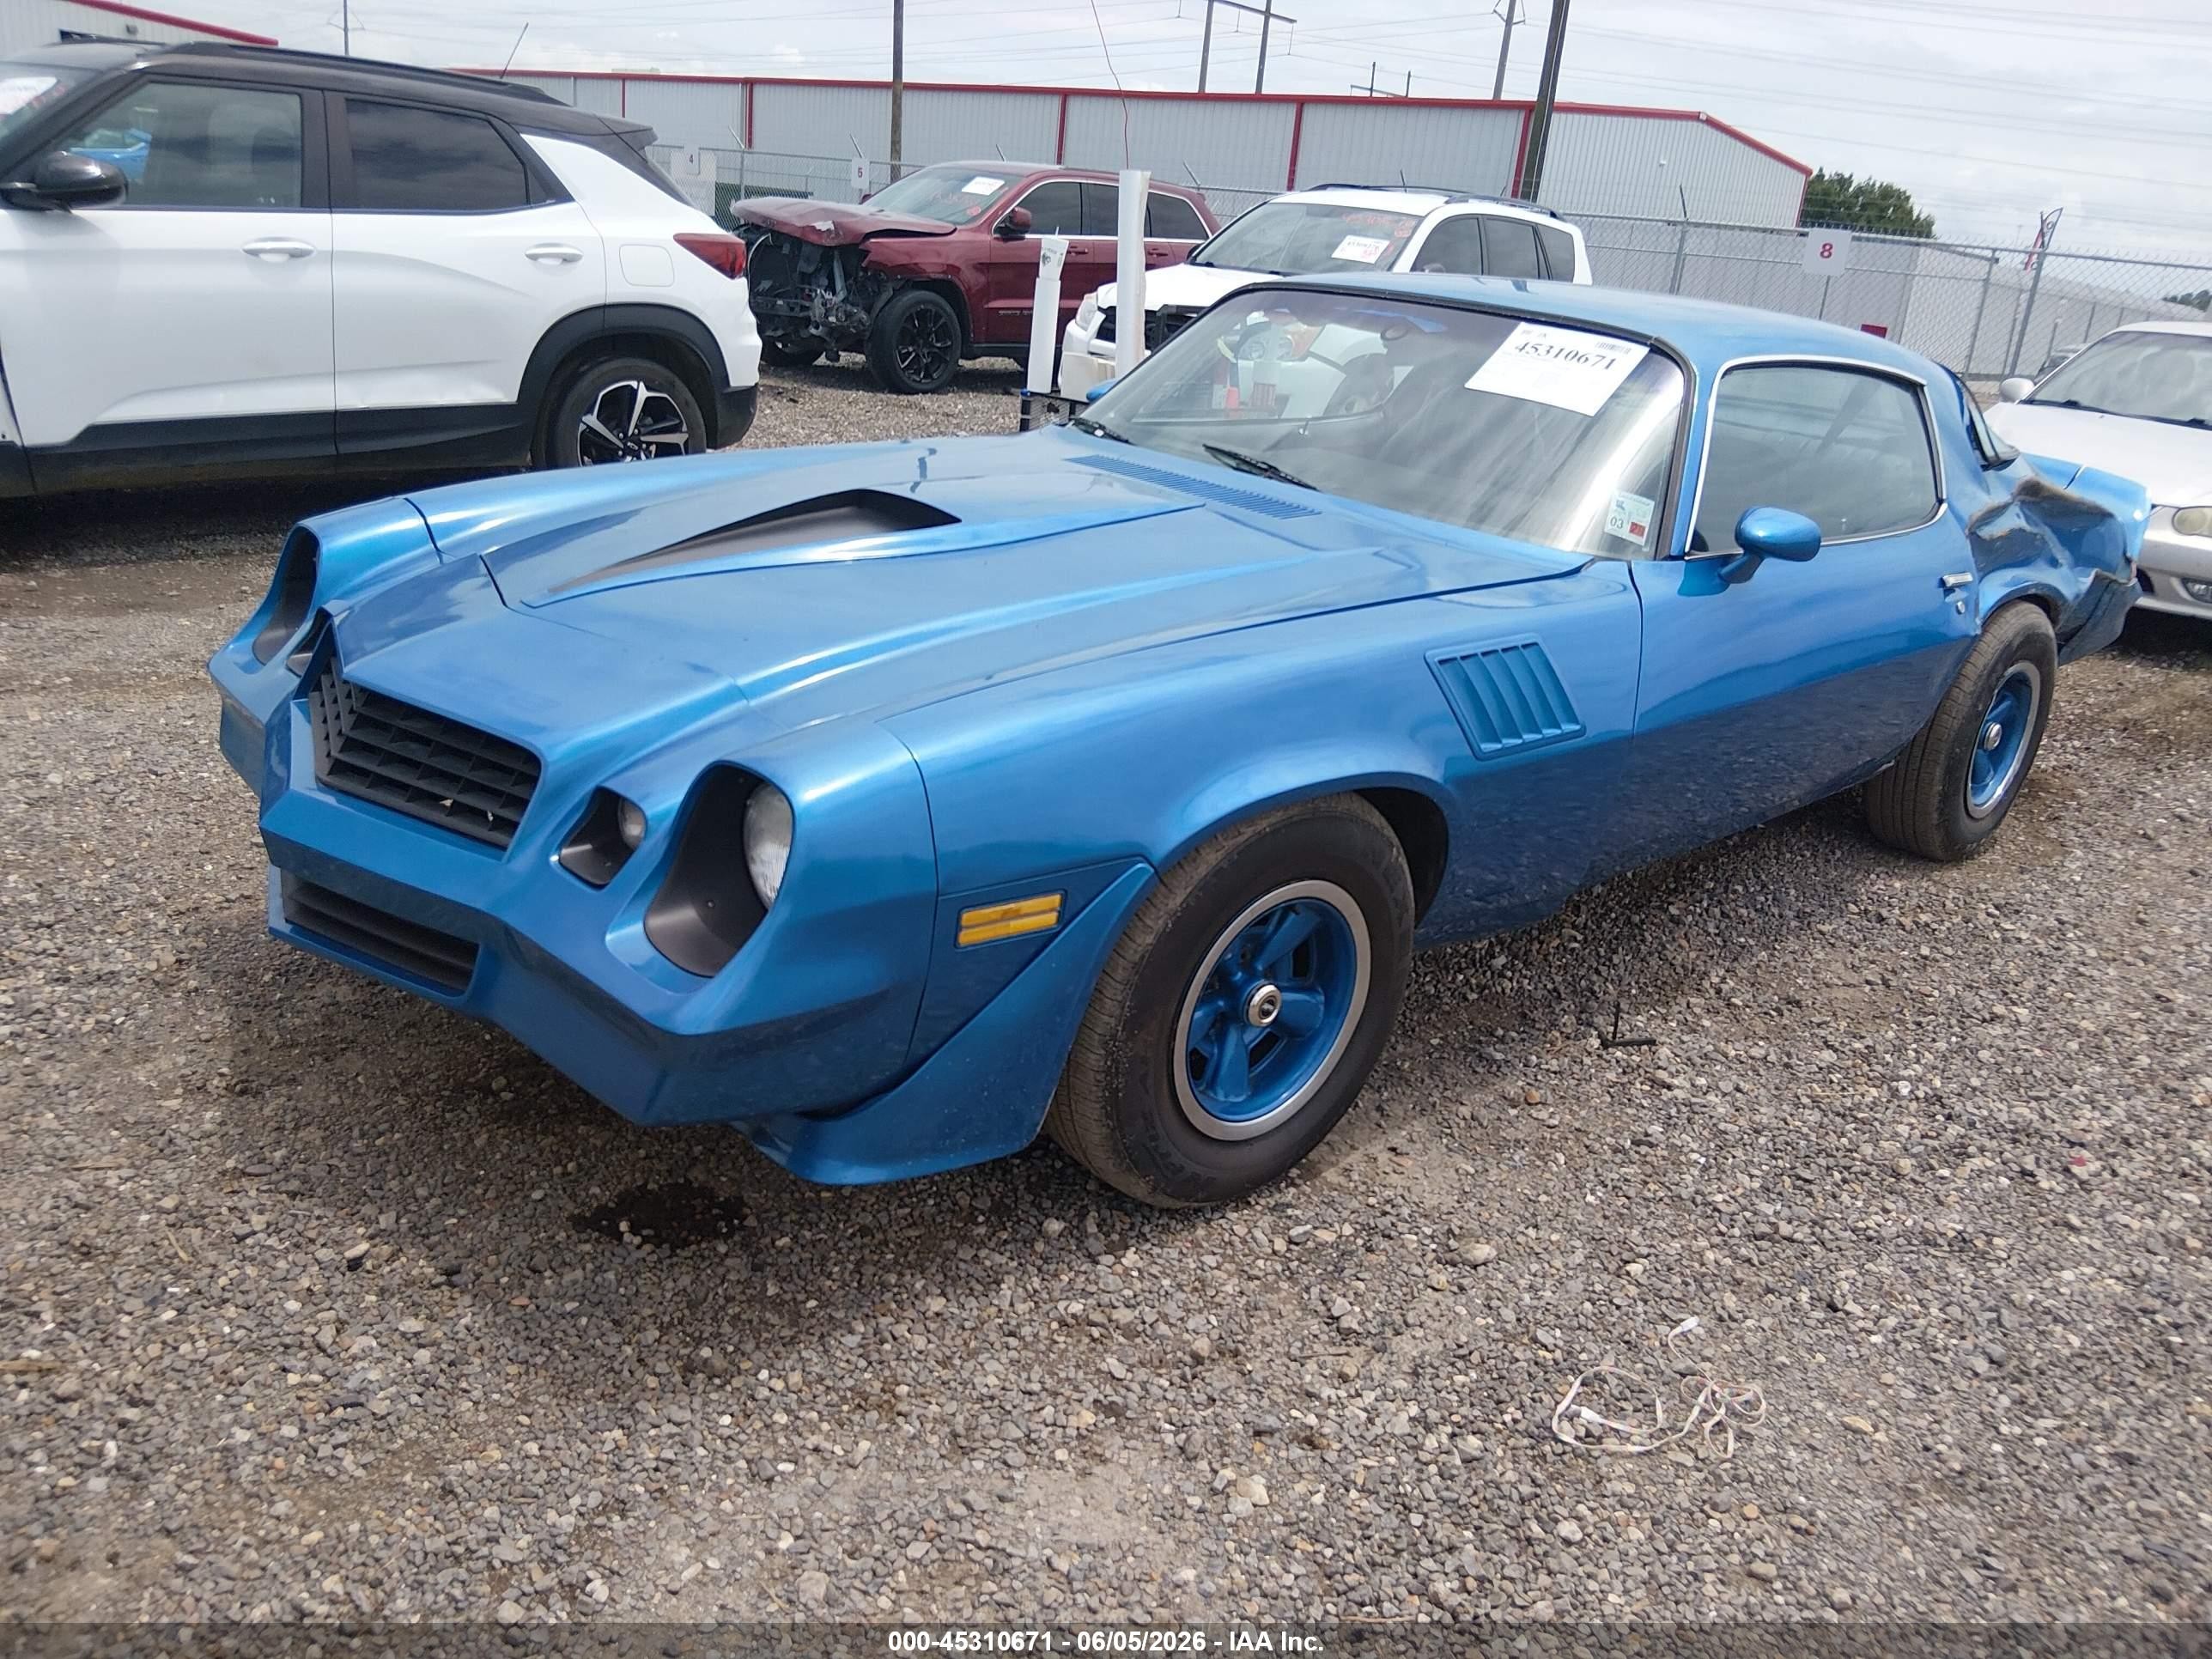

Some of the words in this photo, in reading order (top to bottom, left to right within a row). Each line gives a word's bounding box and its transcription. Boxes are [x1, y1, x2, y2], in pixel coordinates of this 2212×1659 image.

[1820, 242, 1833, 258] 8
[1515, 341, 1617, 370] 45310671
[1610, 516, 1624, 529] 03
